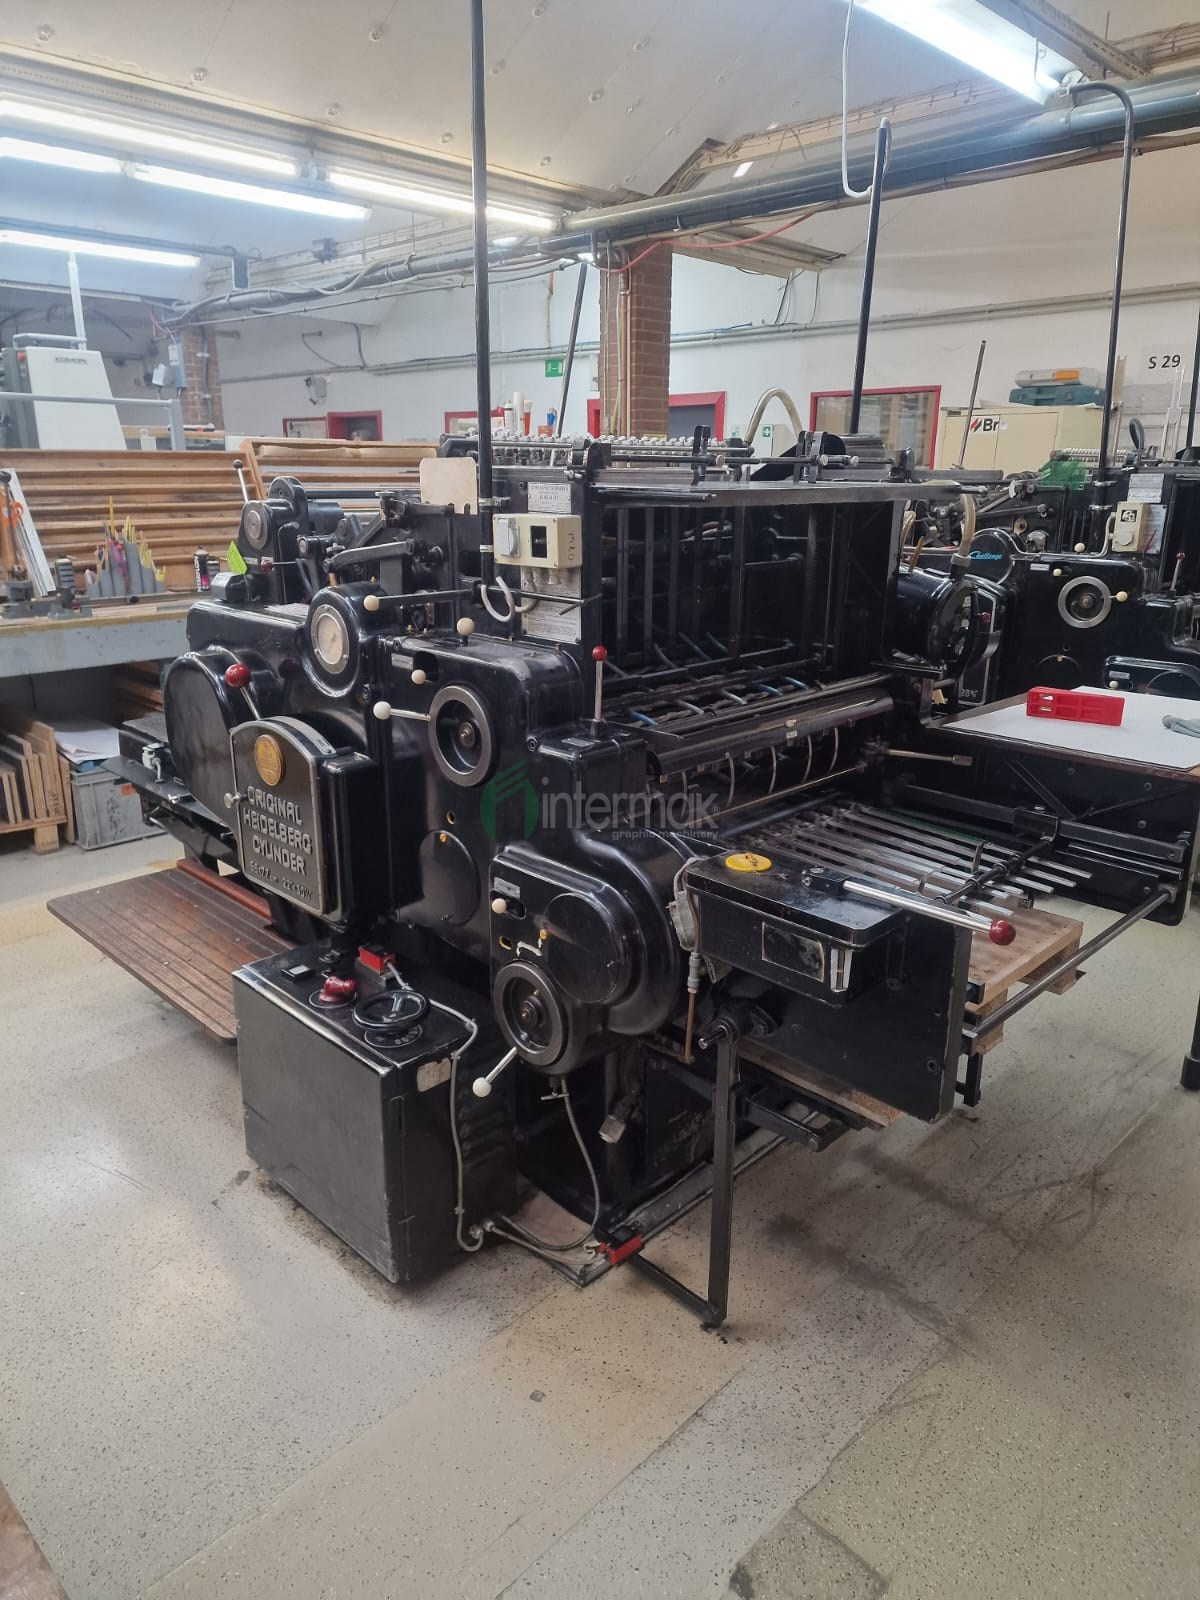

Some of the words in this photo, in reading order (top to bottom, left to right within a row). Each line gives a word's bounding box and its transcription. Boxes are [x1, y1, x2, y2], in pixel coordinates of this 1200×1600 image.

[1148, 356, 1157, 369] S
[1161, 354, 1181, 368] 29
[247, 786, 303, 826] ORIGINAL
[243, 807, 312, 855] HEIDELBERG
[252, 834, 306, 876] CYLINDER
